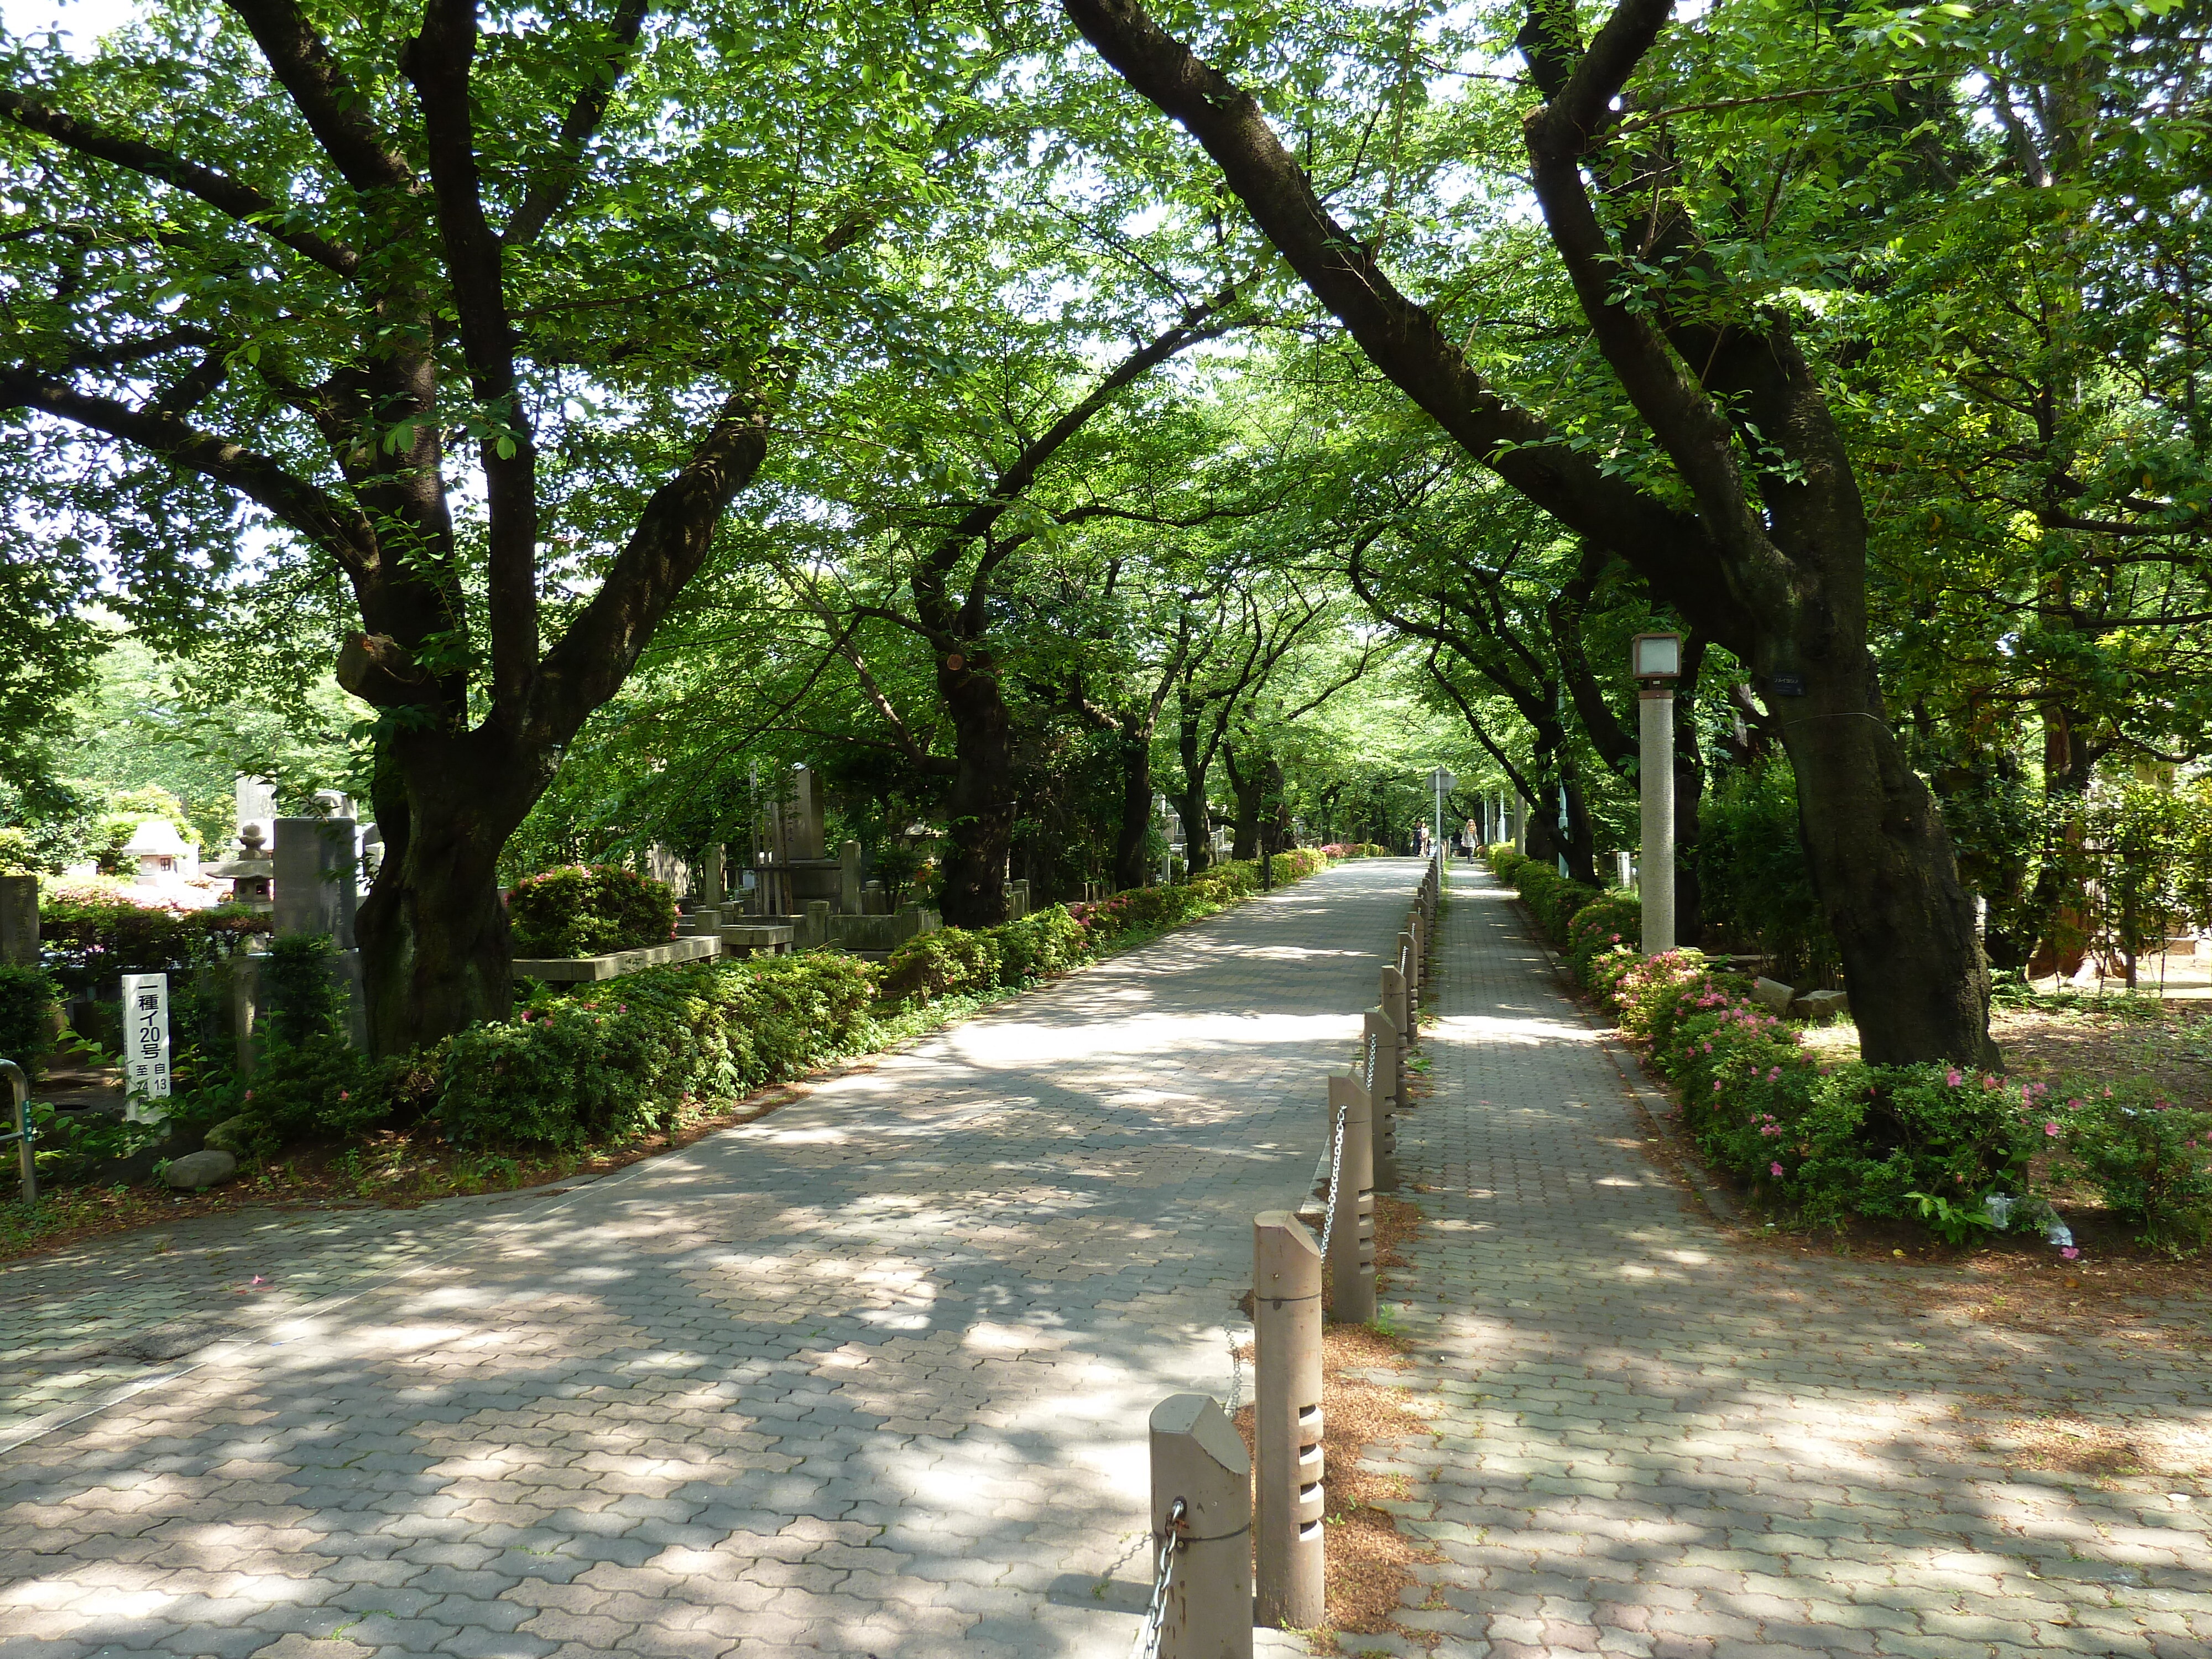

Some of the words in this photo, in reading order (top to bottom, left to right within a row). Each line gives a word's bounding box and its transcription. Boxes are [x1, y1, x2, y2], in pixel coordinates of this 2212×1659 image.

[138, 985, 161, 1060] 一種イ20号
[154, 1062, 167, 1099] 自13
